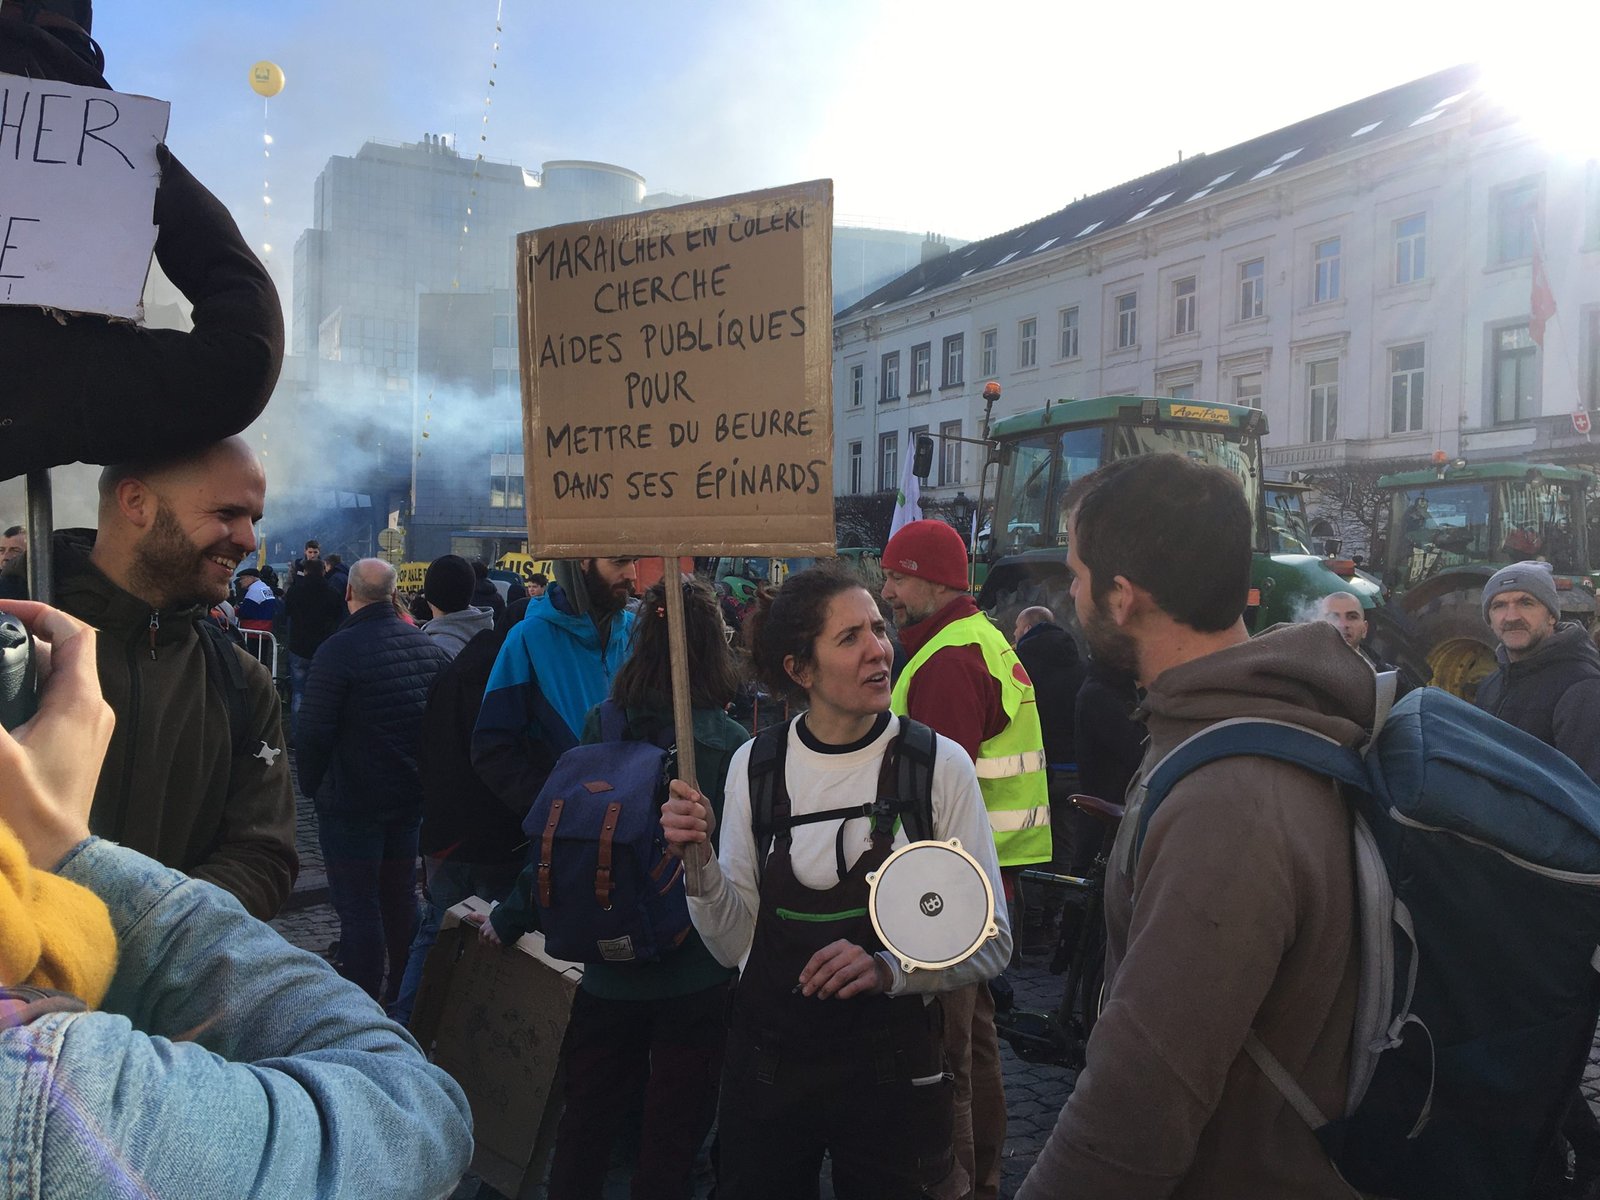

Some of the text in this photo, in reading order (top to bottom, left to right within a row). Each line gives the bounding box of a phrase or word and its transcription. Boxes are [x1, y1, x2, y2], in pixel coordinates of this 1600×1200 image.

[686, 225, 718, 251] EN
[594, 264, 731, 314] CHERCHE
[625, 370, 695, 409] POUR
[547, 408, 817, 458] METTRE DU BEURRE
[553, 470, 613, 500] DANS
[628, 470, 679, 500] SES
